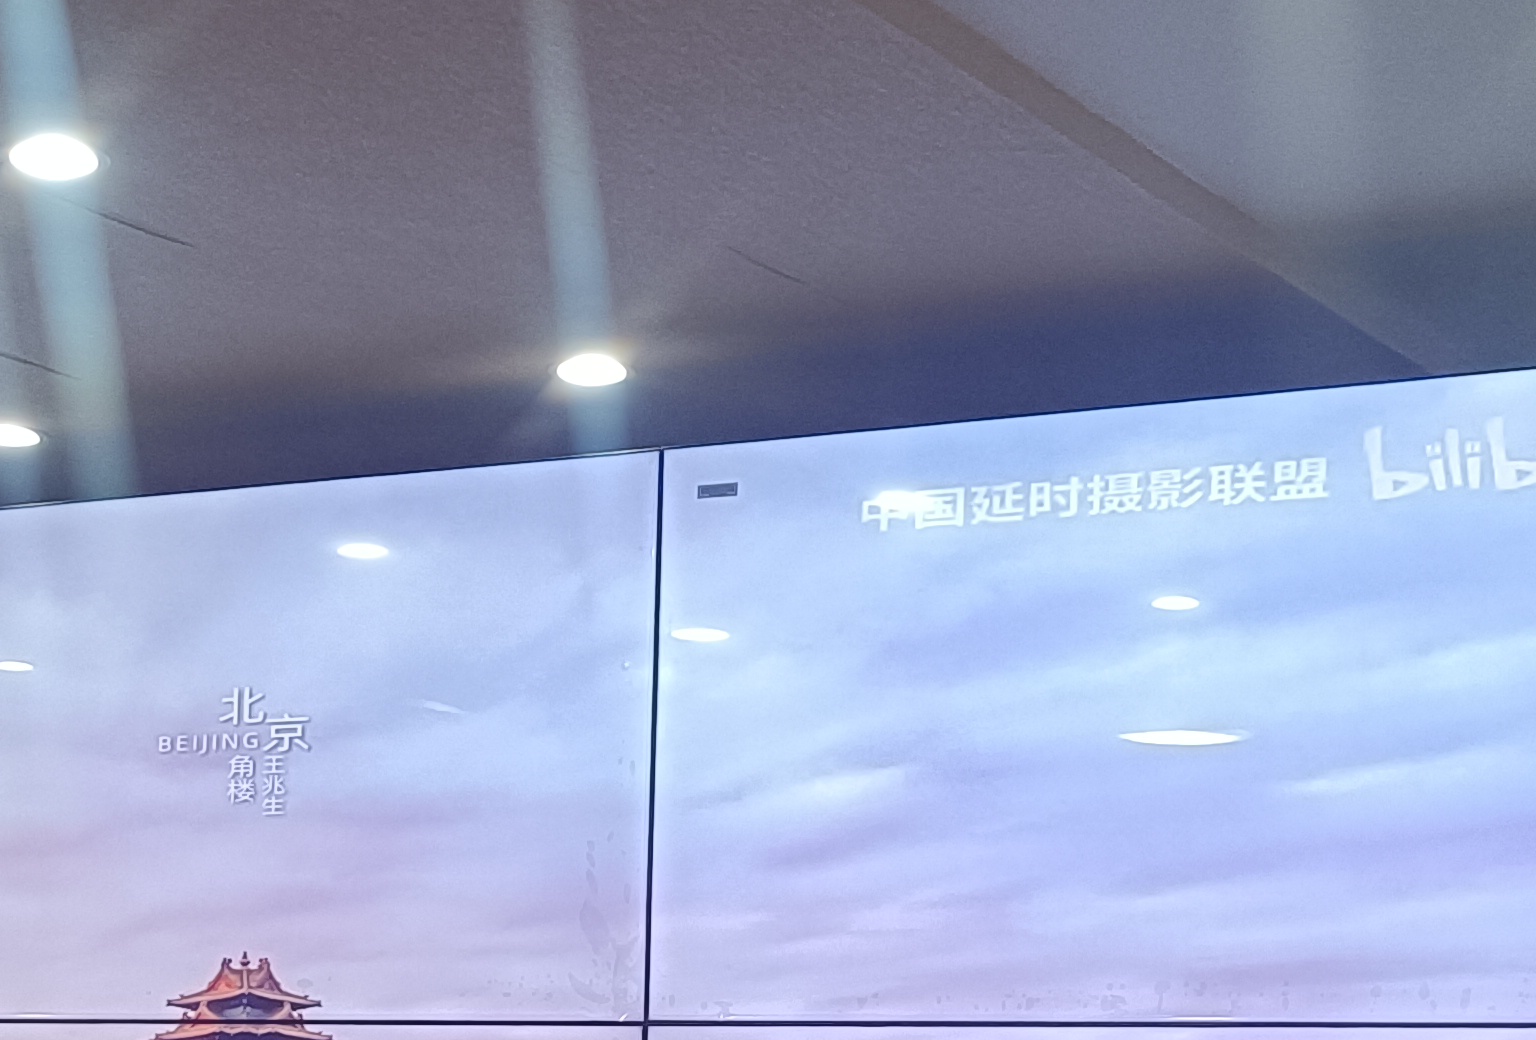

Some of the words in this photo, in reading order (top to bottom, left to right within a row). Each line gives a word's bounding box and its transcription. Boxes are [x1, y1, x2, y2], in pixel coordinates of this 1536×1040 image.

[860, 457, 1330, 532] 中国延时摄影联盟
[158, 731, 260, 755] BEIJING
[218, 686, 311, 754] 北京
[227, 754, 256, 805] 角楼
[262, 755, 286, 817] 王兆生
